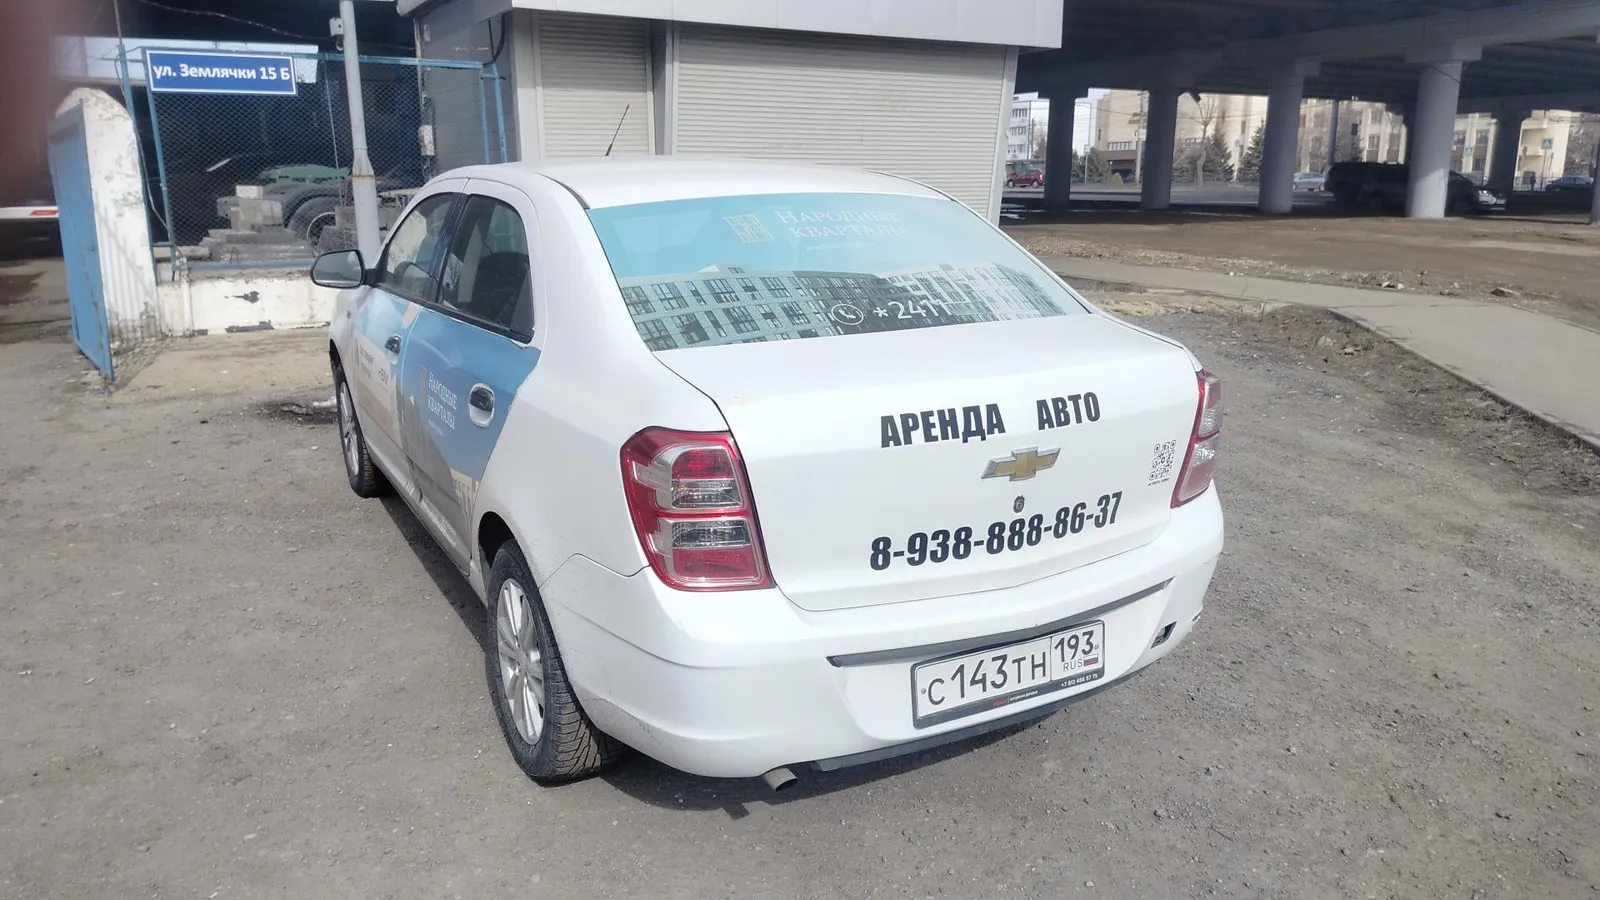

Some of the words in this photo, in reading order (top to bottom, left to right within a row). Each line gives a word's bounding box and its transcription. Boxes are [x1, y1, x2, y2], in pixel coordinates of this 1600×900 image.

[153, 65, 176, 79] ул.
[179, 63, 256, 79] Землячки
[260, 66, 277, 80] 15
[280, 67, 291, 81] Б
[880, 403, 1006, 448] АРЕНДА
[1036, 392, 1101, 430] АВТО
[870, 491, 1123, 570] 8-938-888-86-37
[1054, 630, 1095, 662] 193
[1063, 657, 1083, 672] RUS
